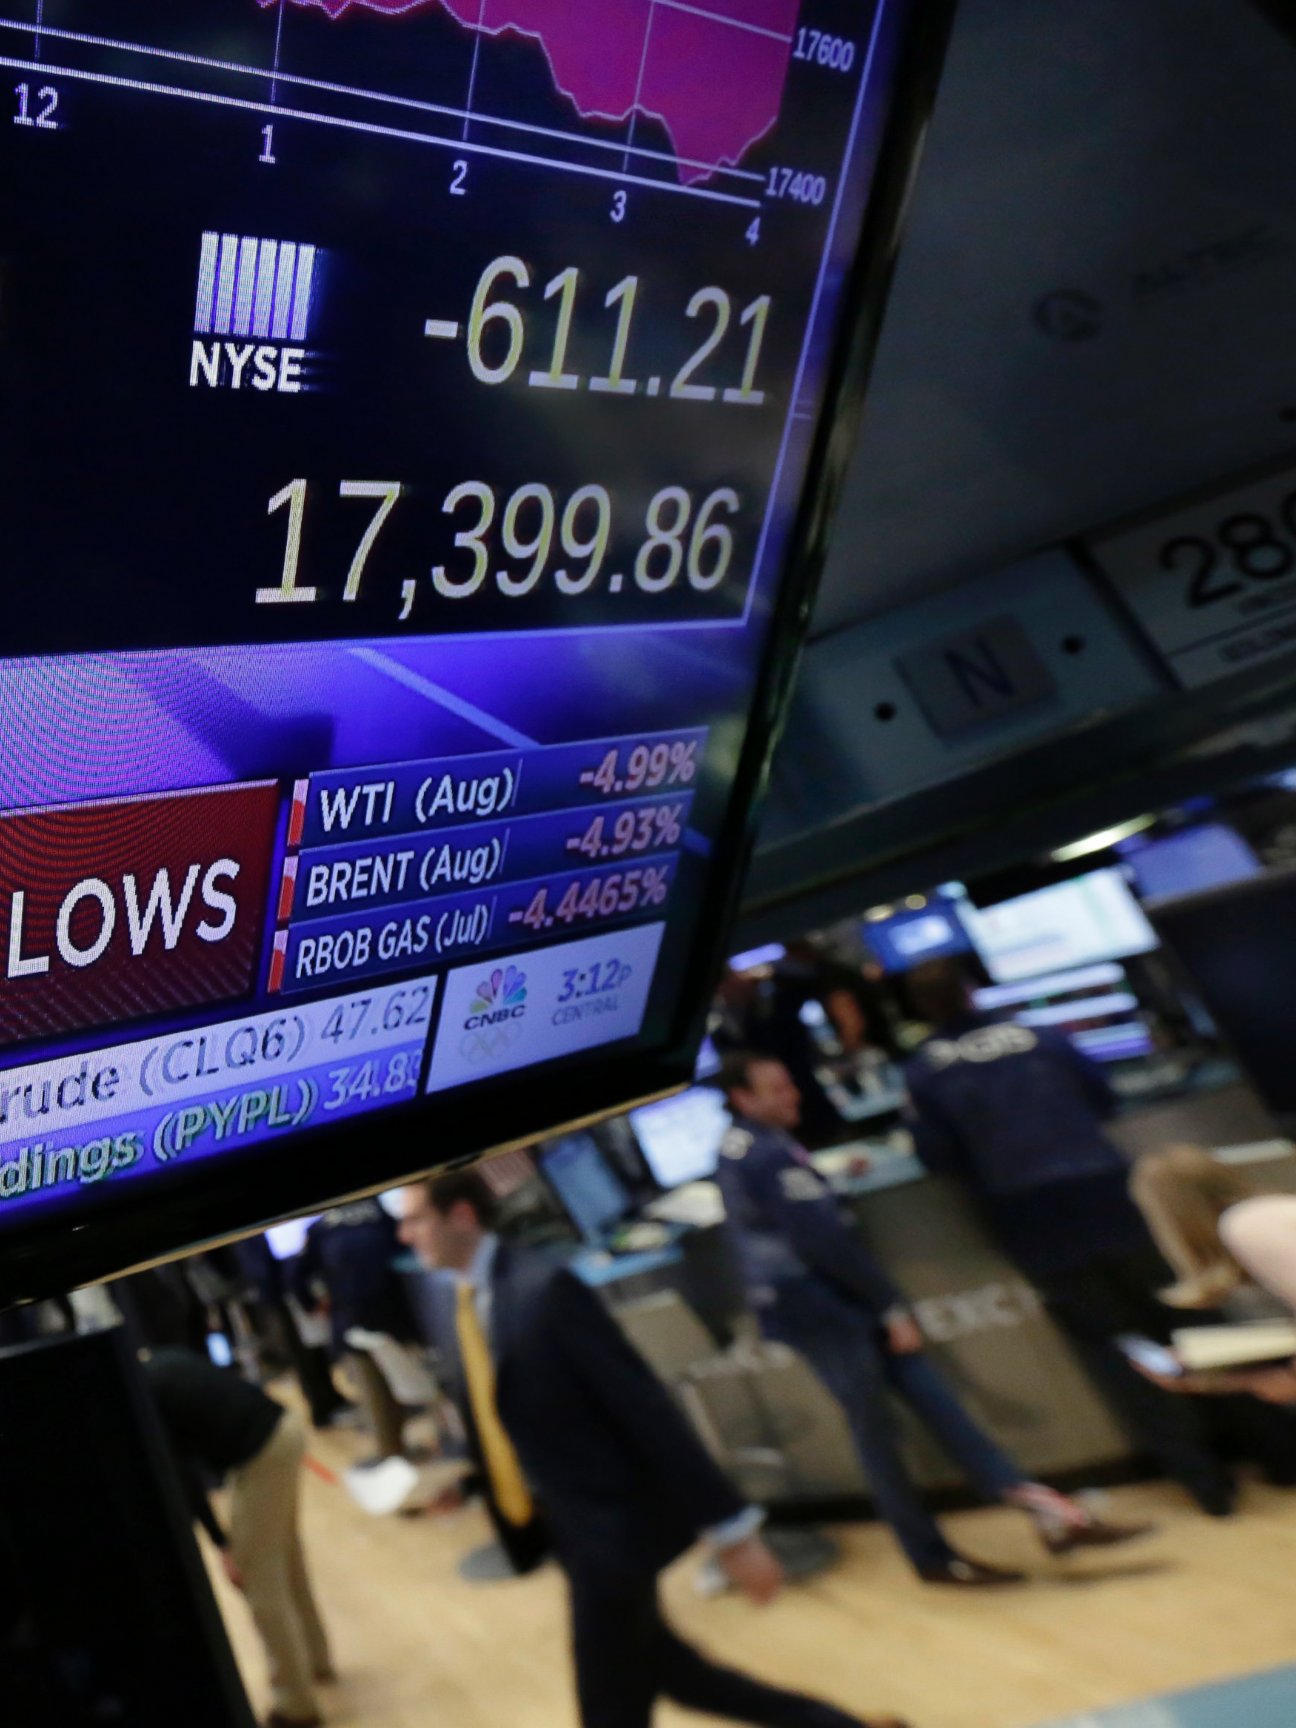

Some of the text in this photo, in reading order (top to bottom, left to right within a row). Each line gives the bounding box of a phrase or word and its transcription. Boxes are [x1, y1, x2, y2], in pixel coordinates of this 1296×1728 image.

[793, 27, 855, 72] 17600
[13, 82, 61, 130] 12
[257, 124, 276, 164] 1
[449, 159, 468, 196] 2
[610, 190, 628, 223] 3
[745, 217, 762, 247] 4
[765, 166, 826, 206] 17400
[188, 340, 307, 393] NYSE
[424, 255, 772, 405] -611.21
[255, 478, 741, 621] 17,399.86
[944, 636, 1016, 708] N
[319, 740, 698, 833] WTI (Aug) -4.99%
[306, 803, 681, 908] BRENT (Aug) -4.93%
[6, 858, 241, 978] LOWS
[295, 865, 668, 979] RBOB GAS (Jul) -4.4465%
[139, 1015, 305, 1097] (CLQ6)
[321, 986, 430, 1045] 47.62
[463, 1004, 527, 1031] CNBC
[551, 996, 619, 1027] CENTRAL
[154, 1078, 320, 1162] (PYPL)
